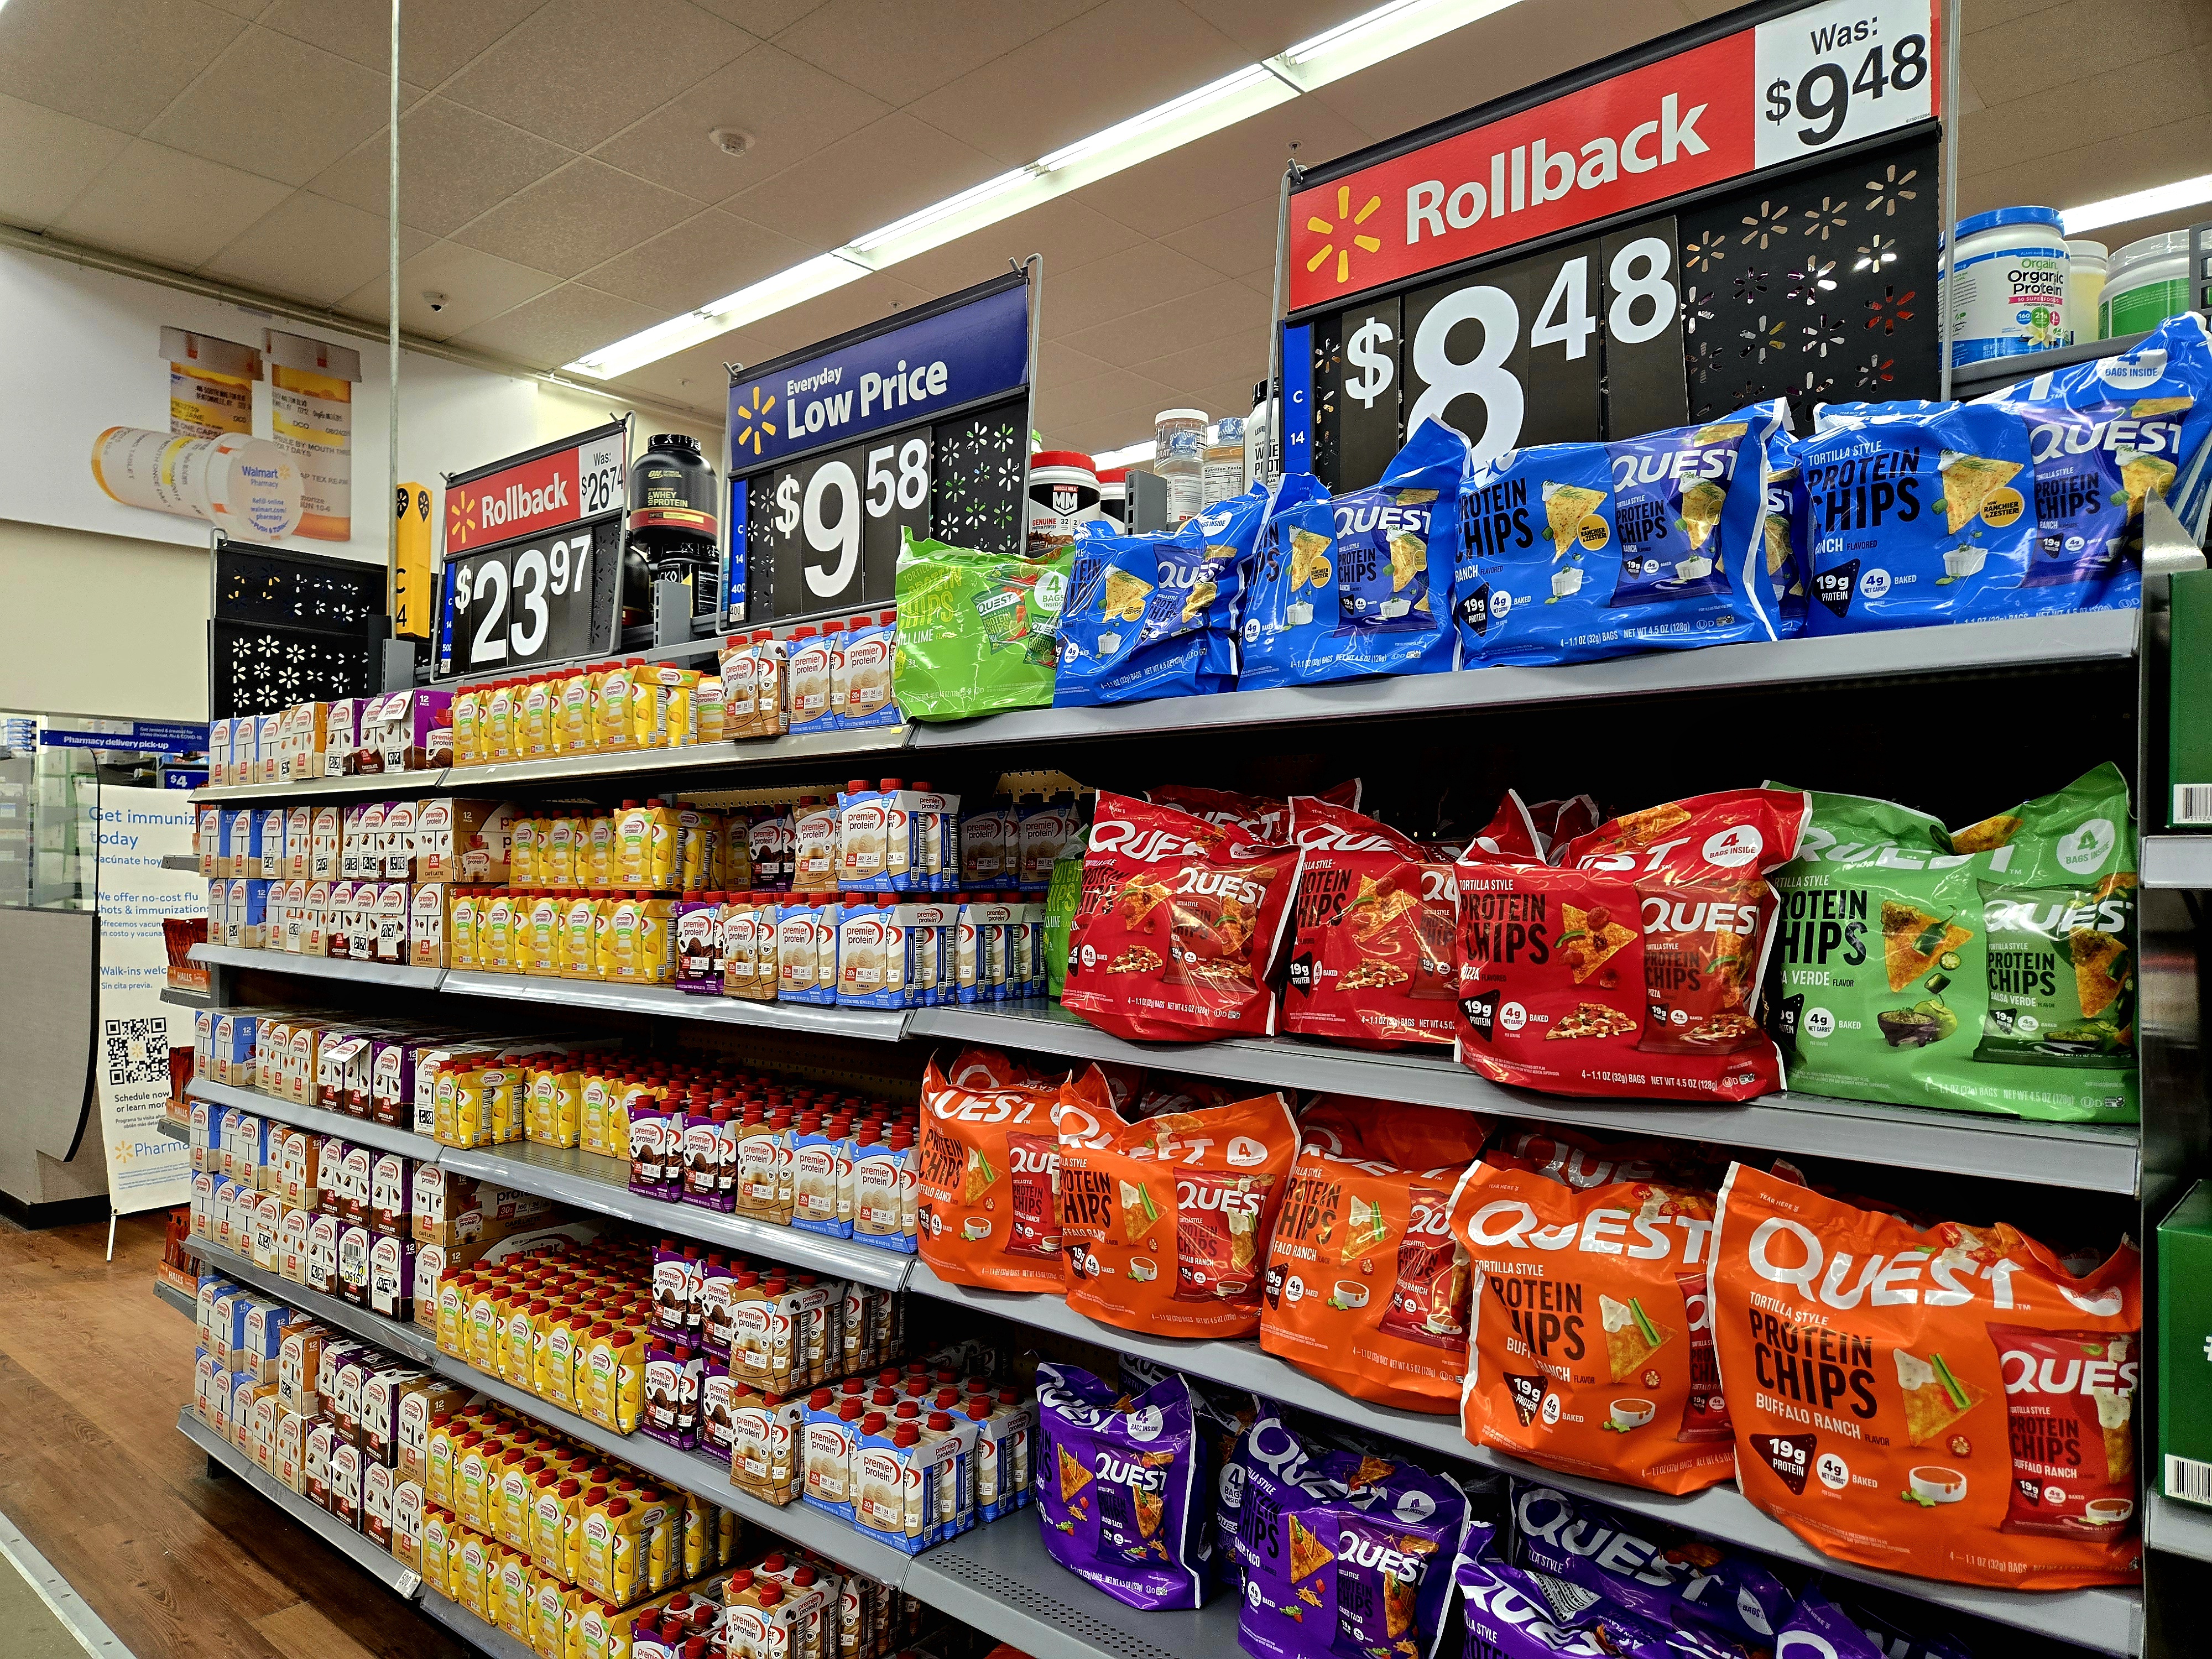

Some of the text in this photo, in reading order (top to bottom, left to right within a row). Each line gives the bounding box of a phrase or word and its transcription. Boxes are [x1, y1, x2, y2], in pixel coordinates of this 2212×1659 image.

[1811, 17, 1879, 53] Was:
[1406, 92, 1710, 245] Rollback
[2021, 258, 2056, 270] Orgain
[2008, 270, 2064, 284] Organic
[2013, 283, 2062, 296] Protein
[2128, 367, 2158, 377] INSIDE
[786, 367, 843, 397] Everyday
[787, 359, 948, 438] Low Price
[1293, 391, 1304, 404] C
[1290, 432, 1305, 445] 14
[593, 450, 612, 466] Was:
[1808, 440, 1882, 467] TORTILLA STYLE
[242, 466, 278, 478] Walmart
[1612, 448, 1739, 492] QUEST
[251, 478, 278, 489] Pharmacy
[2034, 472, 2099, 497] PROTEIN
[481, 472, 568, 528] Rollback
[653, 499, 688, 508] PROTEIN
[1983, 500, 2019, 513] RANCHIER
[2036, 490, 2101, 520] CHIPS
[1616, 499, 1665, 523] PROTEIN
[1032, 518, 1057, 526] GENUINE
[738, 525, 743, 534] C
[1618, 517, 1667, 543] CHIPS
[1846, 539, 1877, 551] FLAVORED
[735, 555, 743, 564] 14
[1455, 565, 1478, 582] RANCH
[732, 584, 745, 593] 400
[1046, 574, 1062, 592] 4
[1816, 575, 1917, 591] 19g 4g BAKED
[975, 592, 1016, 615] QUEST
[914, 630, 933, 642] LIME
[1602, 622, 1690, 641] BAGS NET WT 4.5 OZ (128g)
[794, 650, 820, 667] premier
[849, 646, 879, 658] premier
[851, 654, 878, 665] protein
[796, 664, 820, 674] protein
[64, 736, 169, 749] Pharmacy delivery pick-up
[170, 774, 187, 787] $4
[89, 807, 195, 825] Get immuniz
[847, 812, 878, 823] premier
[849, 820, 875, 831] protein
[90, 831, 138, 850] today
[1721, 833, 1739, 847] 4
[1729, 846, 1757, 856] INSIDE
[2065, 852, 2089, 865] BAGS
[1176, 867, 1266, 907] QUEST
[1459, 879, 1514, 890] TORTILLA STYLE
[114, 893, 139, 901] offer
[126, 905, 132, 914] &
[1461, 893, 1546, 924] PROTEIN
[846, 926, 875, 937] premier
[847, 935, 873, 947] protein
[1465, 922, 1548, 964] CHIPS
[1988, 952, 2055, 970] PROTEIN
[101, 966, 141, 975] Walk-ins
[177, 972, 192, 982] HALLS
[1461, 963, 1480, 982] PIZZA
[129, 982, 152, 990] previa.
[1792, 970, 1854, 988] VERDE FLAVOR
[1989, 969, 2057, 996] CHIPS
[1465, 1000, 1549, 1022] 19g BAKED
[114, 1092, 150, 1102] Schedule
[174, 1106, 187, 1118] HALLS
[135, 1141, 190, 1157] Pharma
[860, 1166, 890, 1179] premier
[862, 1175, 888, 1186] protein
[1759, 1193, 1793, 1211] TEAR HERE
[504, 1217, 541, 1228] CAFÉ LATTE
[1469, 1200, 1713, 1266] QUEST
[451, 1252, 461, 1260] 12
[1515, 1262, 1543, 1276] STYLE
[1747, 1217, 2026, 1310] QUEST
[1749, 1291, 1829, 1326] TORTILLA STYLE
[1749, 1308, 1874, 1369] PROTEIN
[1754, 1342, 1878, 1420] CHIPS
[1755, 1392, 1890, 1447] BUFFALO RANCH FLAVOR
[1143, 1424, 1159, 1433] INSIDE
[1769, 1437, 1878, 1488] 19g 4g BAKED
[1773, 1458, 1805, 1477] PROTEIN
[2044, 1467, 2078, 1480] RANCH
[1339, 1531, 1428, 1586] QUEST
[399, 1575, 411, 1588] 500
